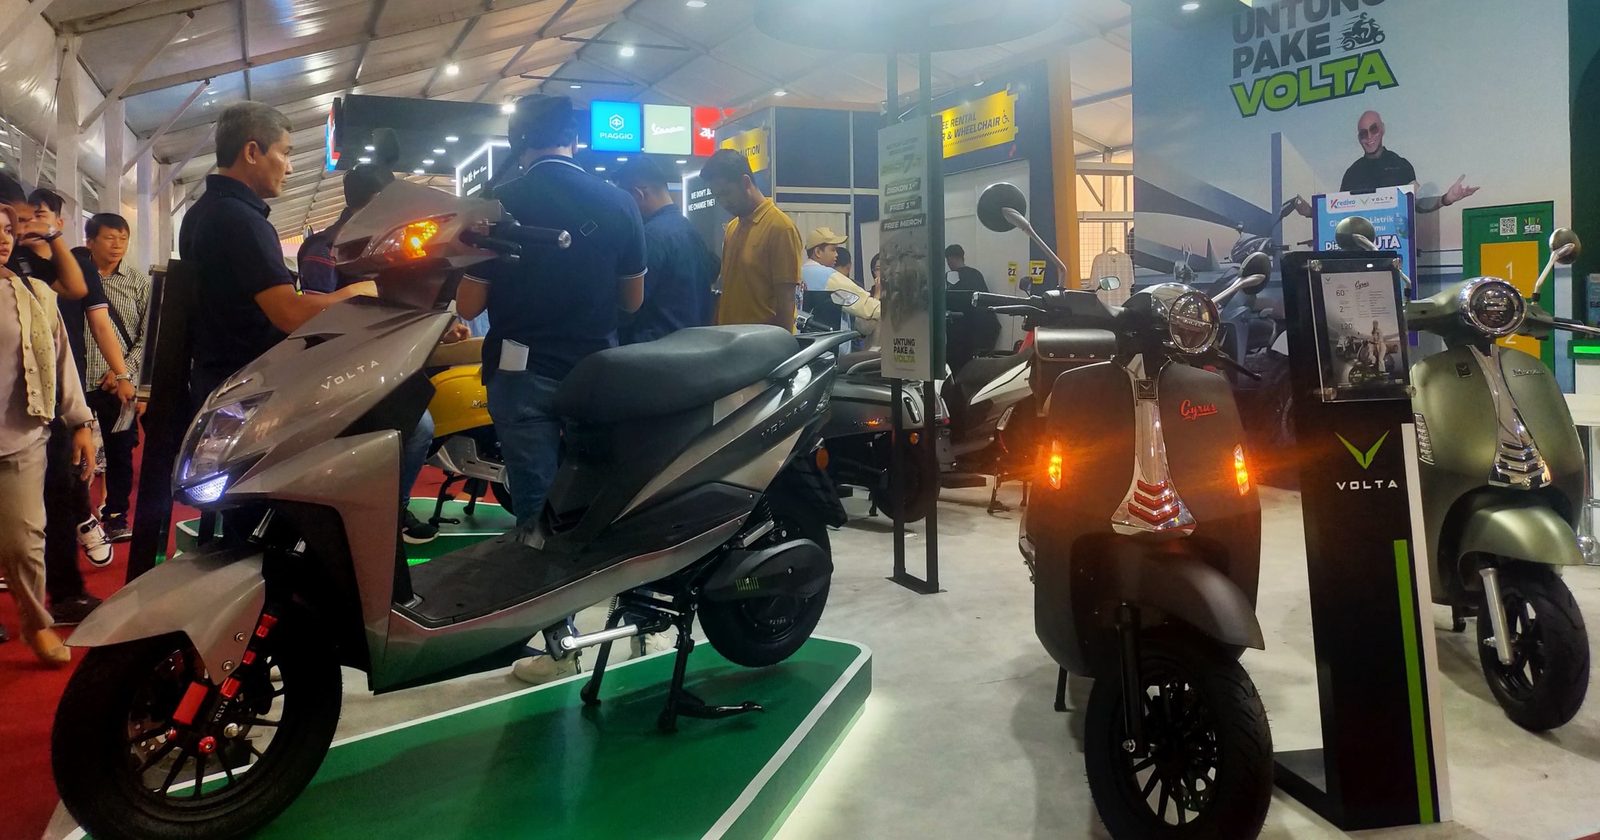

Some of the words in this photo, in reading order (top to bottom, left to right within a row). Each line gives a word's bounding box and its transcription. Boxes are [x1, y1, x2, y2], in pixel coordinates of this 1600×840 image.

[1233, 23, 1331, 79] PAKE
[1229, 49, 1399, 118] VOLTA
[951, 112, 977, 127] RENTAL
[954, 116, 1001, 138] WHEELCHAIR
[600, 132, 633, 140] PIAGGIO
[900, 218, 923, 228] MERCH
[1374, 235, 1400, 249] UTA
[1031, 267, 1045, 275] 17
[893, 338, 915, 346] UNTUNG
[893, 346, 908, 354] PAKE
[321, 360, 380, 390] VOLTA
[1180, 400, 1218, 420] Cyrus
[1336, 479, 1398, 491] VOLTA
[213, 701, 229, 722] VOLTA
